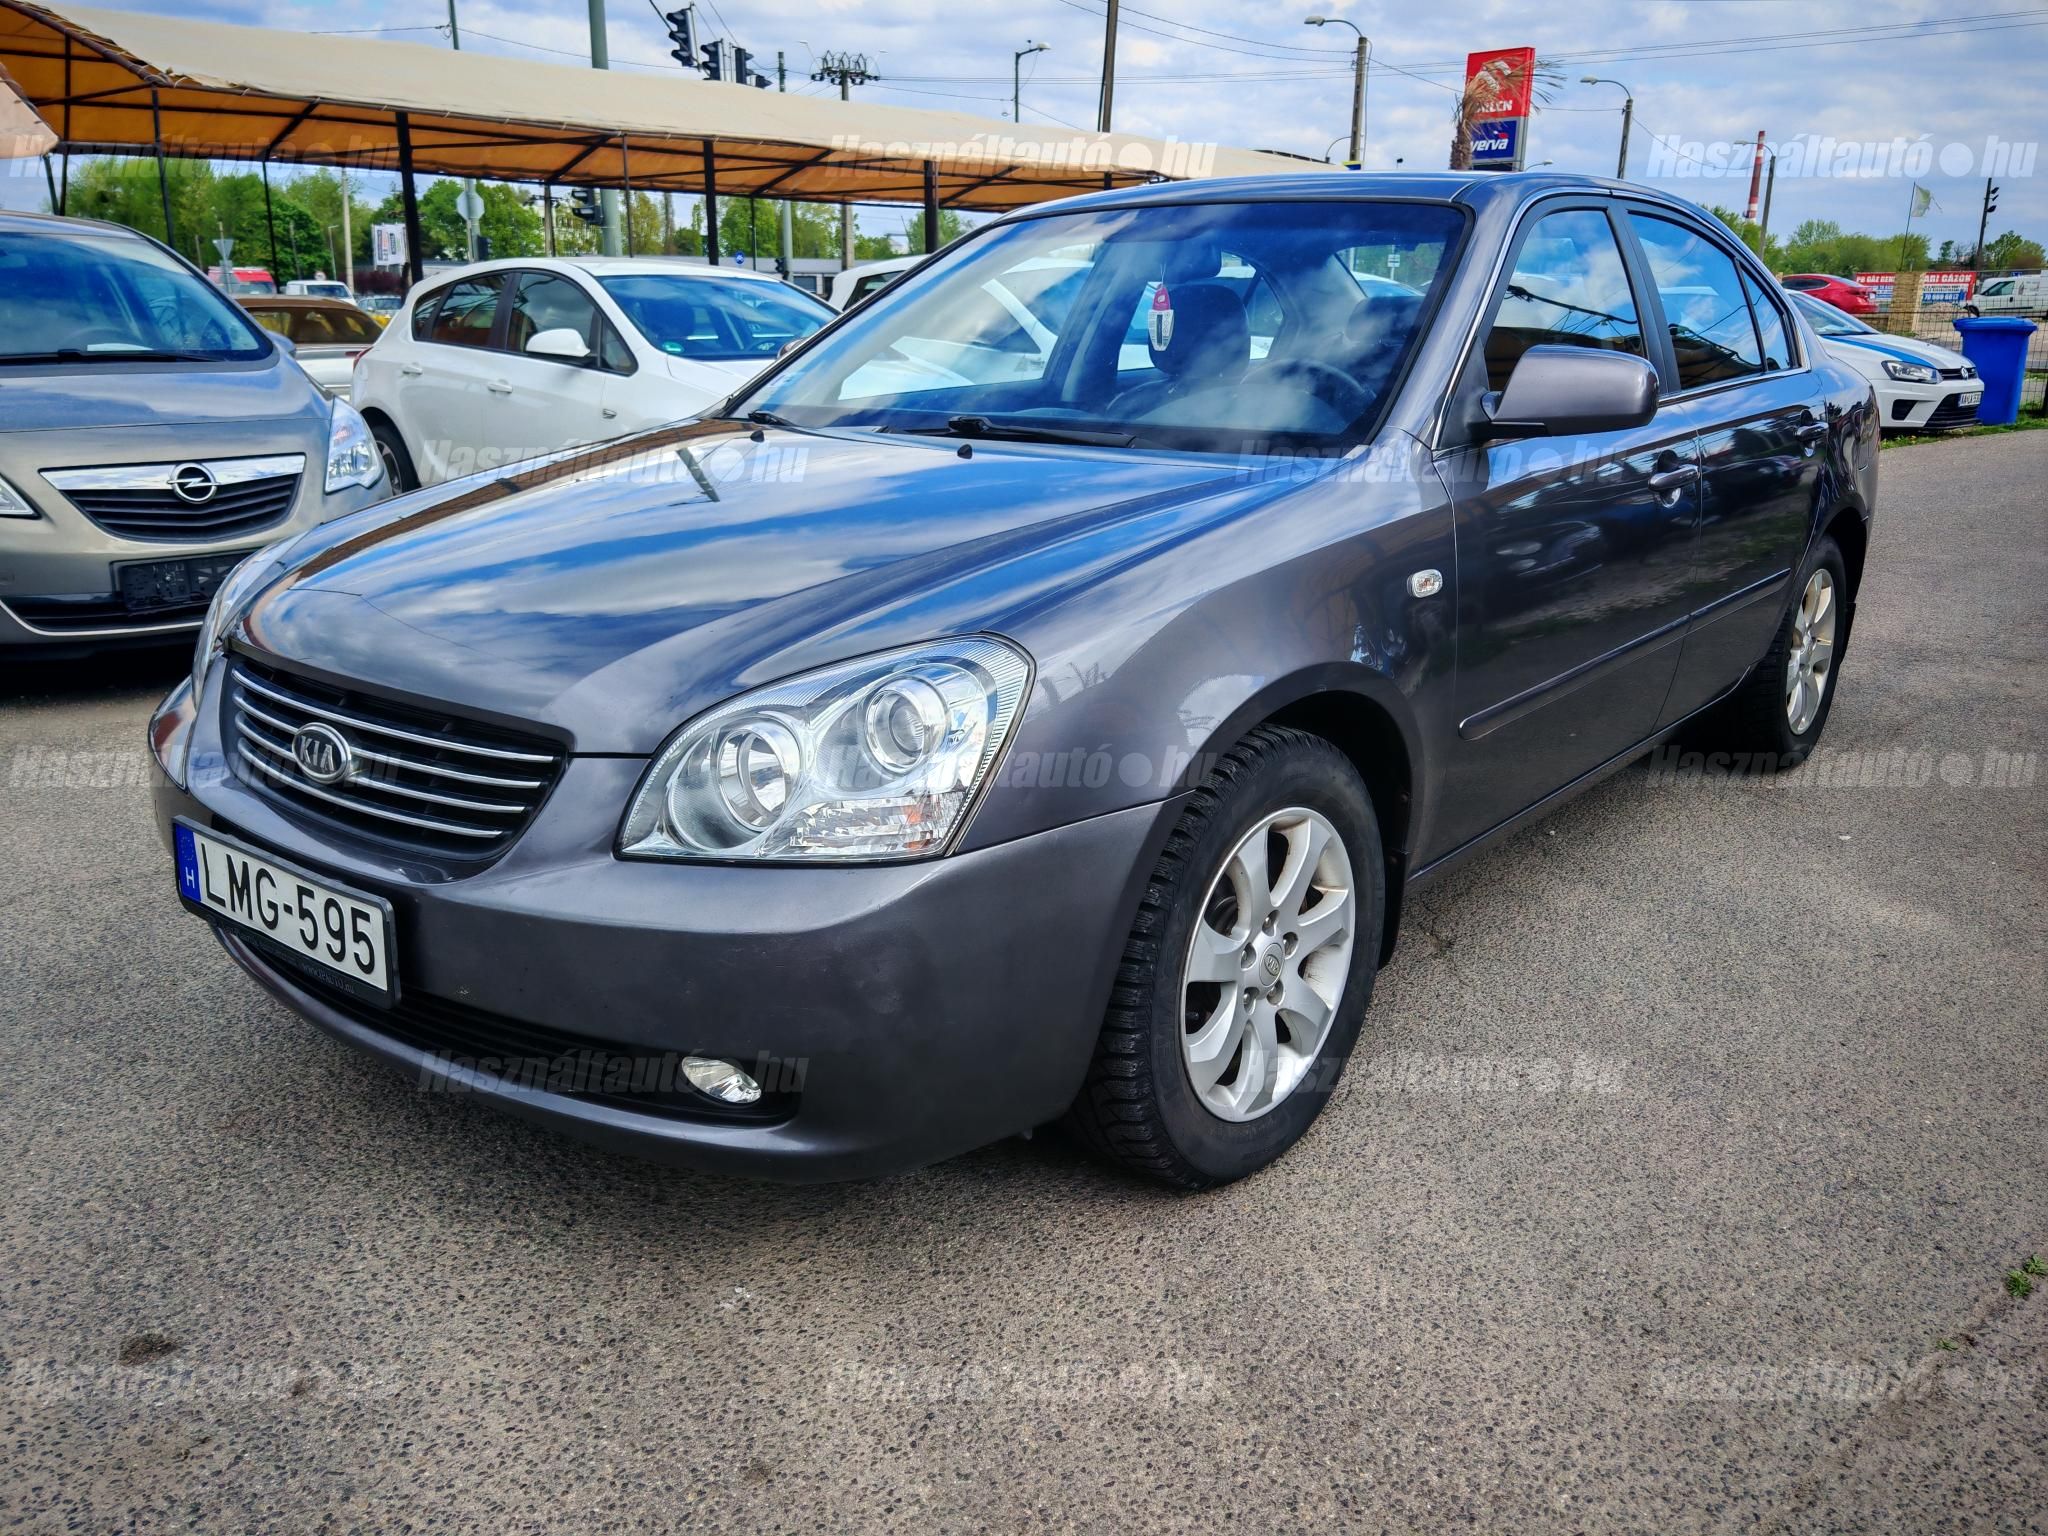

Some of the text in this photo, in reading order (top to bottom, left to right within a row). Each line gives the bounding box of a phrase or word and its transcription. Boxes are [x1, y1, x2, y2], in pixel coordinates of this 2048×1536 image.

[1470, 138, 1508, 152] verva
[300, 735, 335, 772] KIA
[185, 867, 195, 889] H
[201, 843, 375, 975] LMG-595
